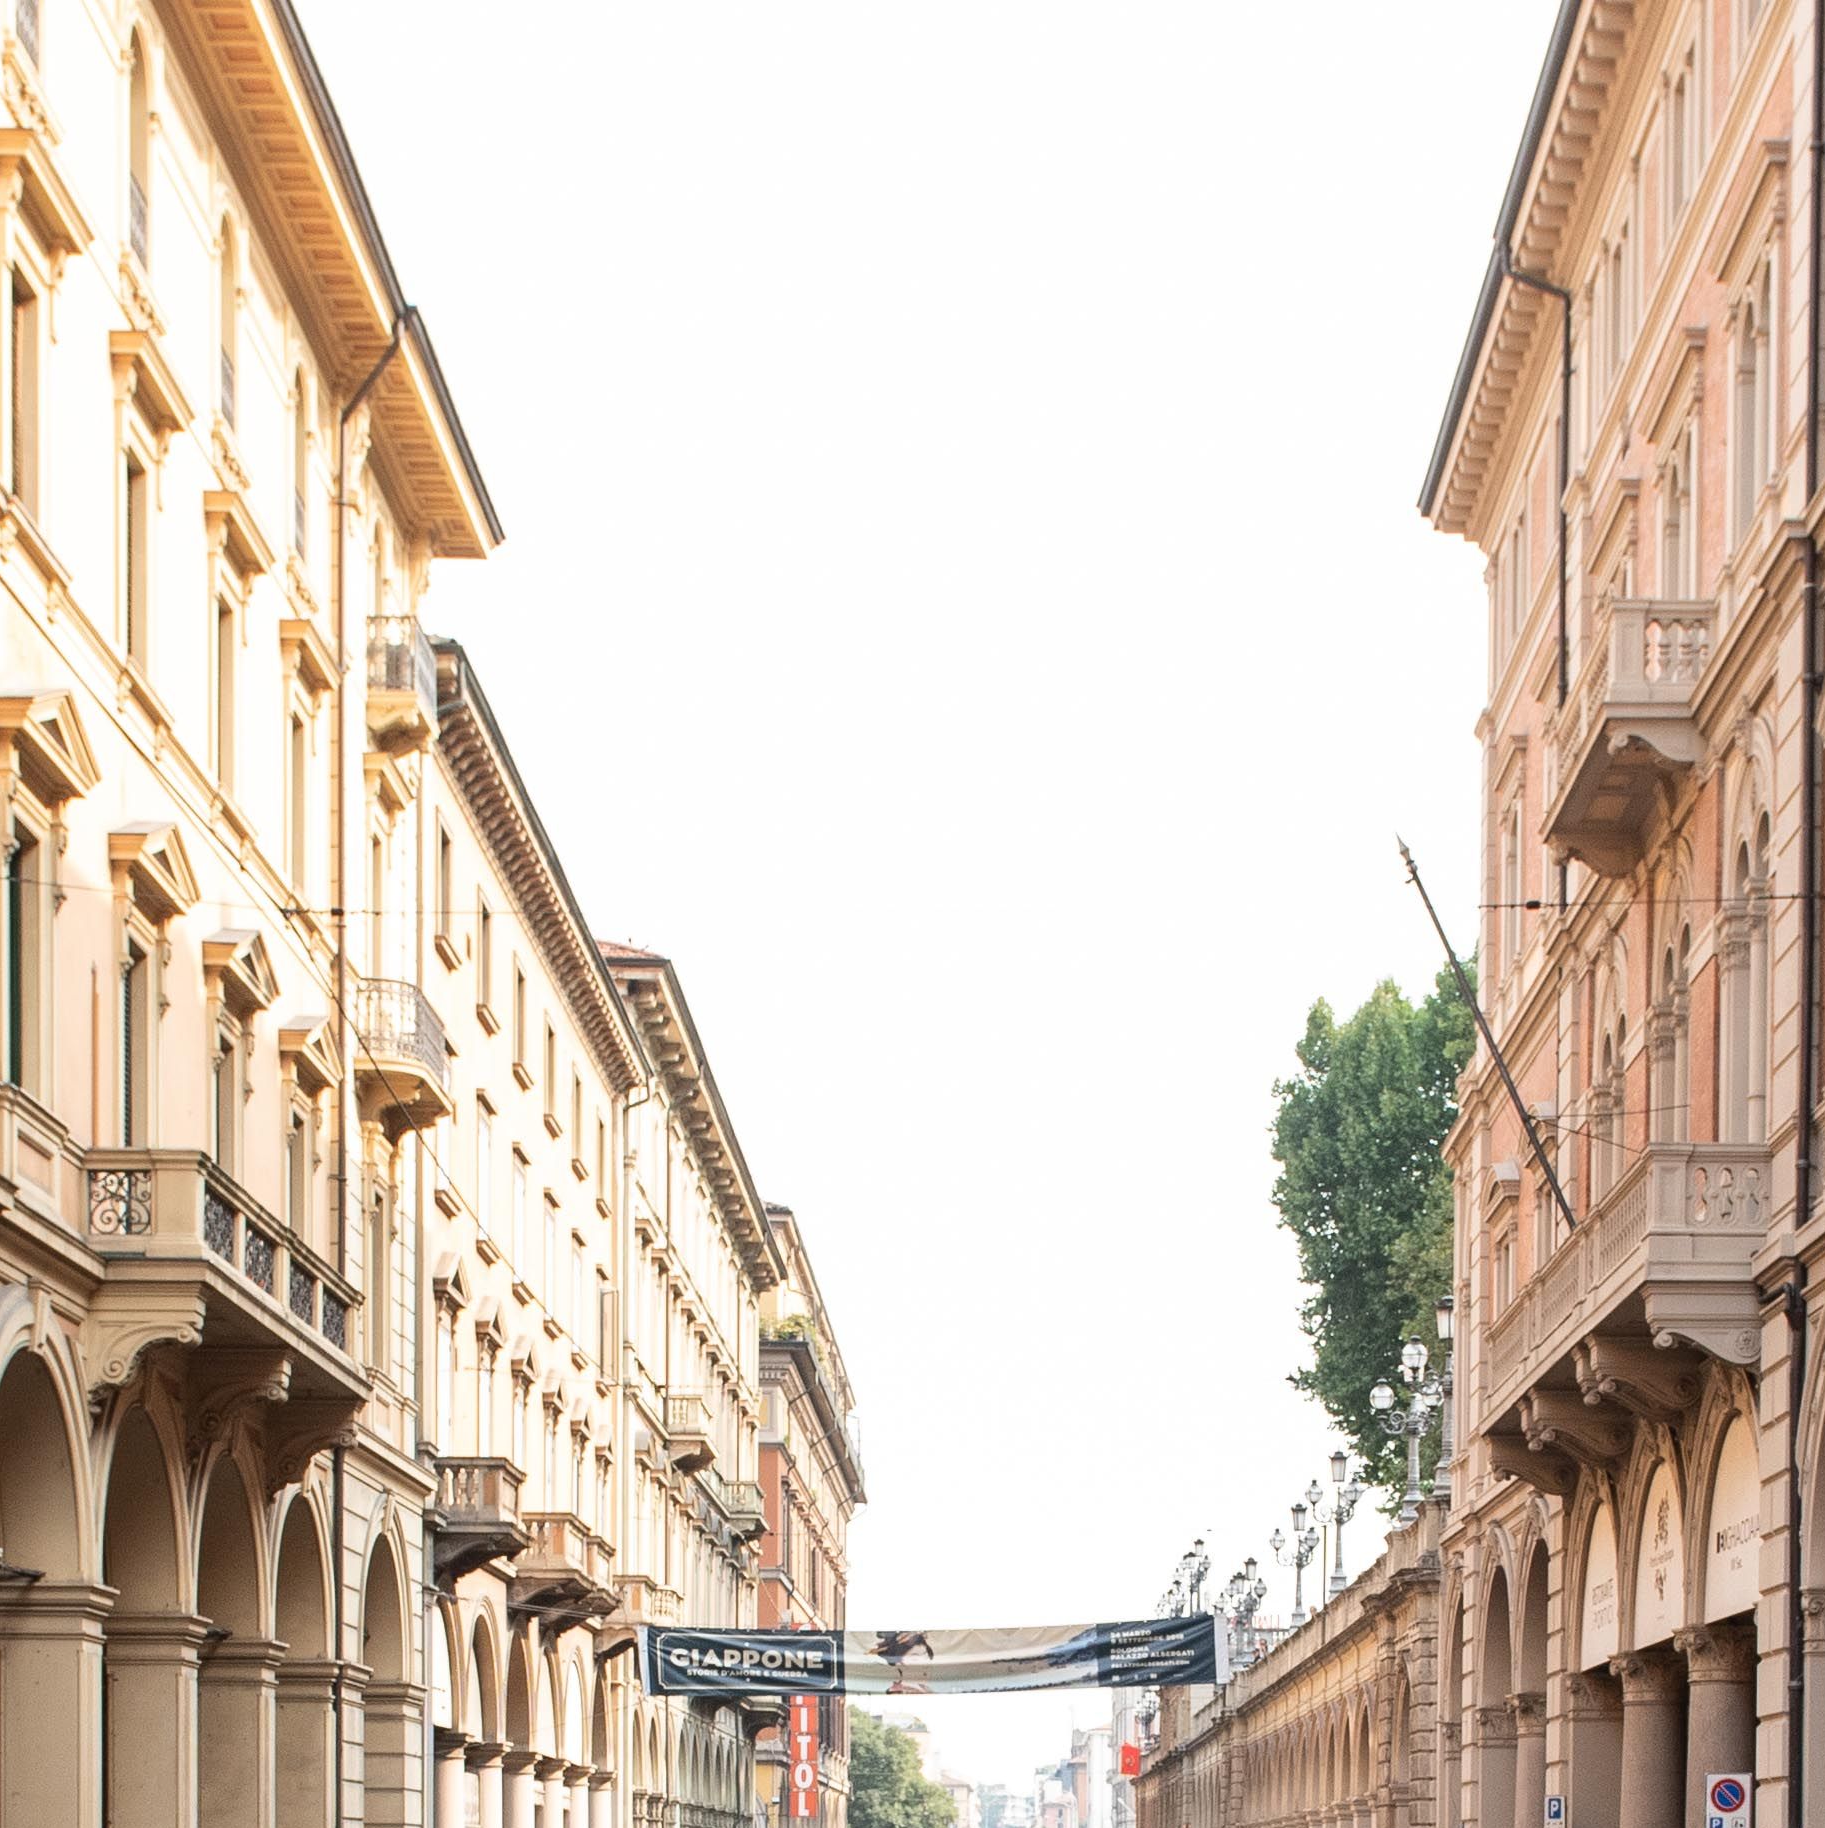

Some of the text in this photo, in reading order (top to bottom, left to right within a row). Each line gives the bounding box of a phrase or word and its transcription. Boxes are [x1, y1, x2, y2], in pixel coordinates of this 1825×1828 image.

[669, 1648, 824, 1669] GIAPPONE
[686, 1669, 719, 1677] STORIE
[720, 1669, 762, 1677] D'AMORE
[771, 1670, 809, 1678] GUERRA
[1550, 1800, 1559, 1817] P
